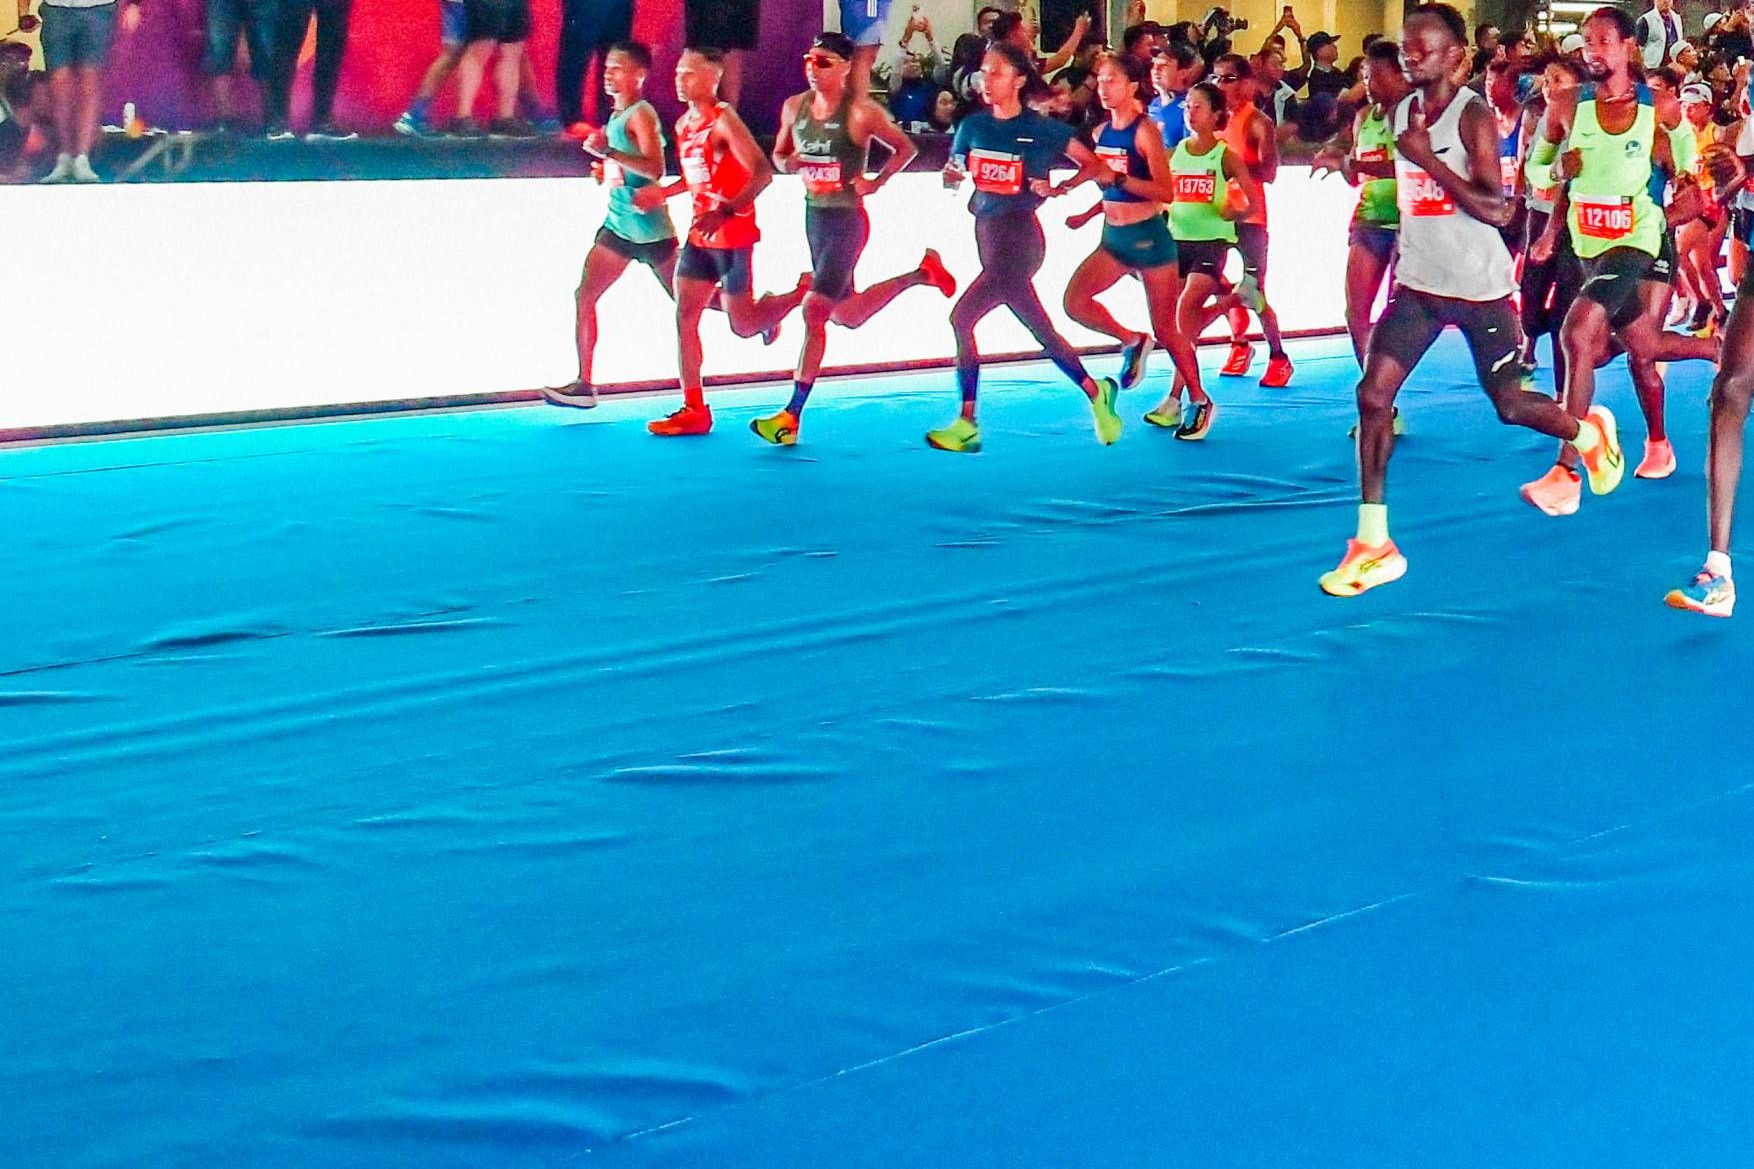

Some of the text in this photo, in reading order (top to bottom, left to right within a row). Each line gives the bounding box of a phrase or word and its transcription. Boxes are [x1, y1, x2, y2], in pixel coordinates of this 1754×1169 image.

[981, 162, 1016, 183] 9264
[1178, 178, 1214, 194] 13753
[1585, 207, 1632, 230] 12106
